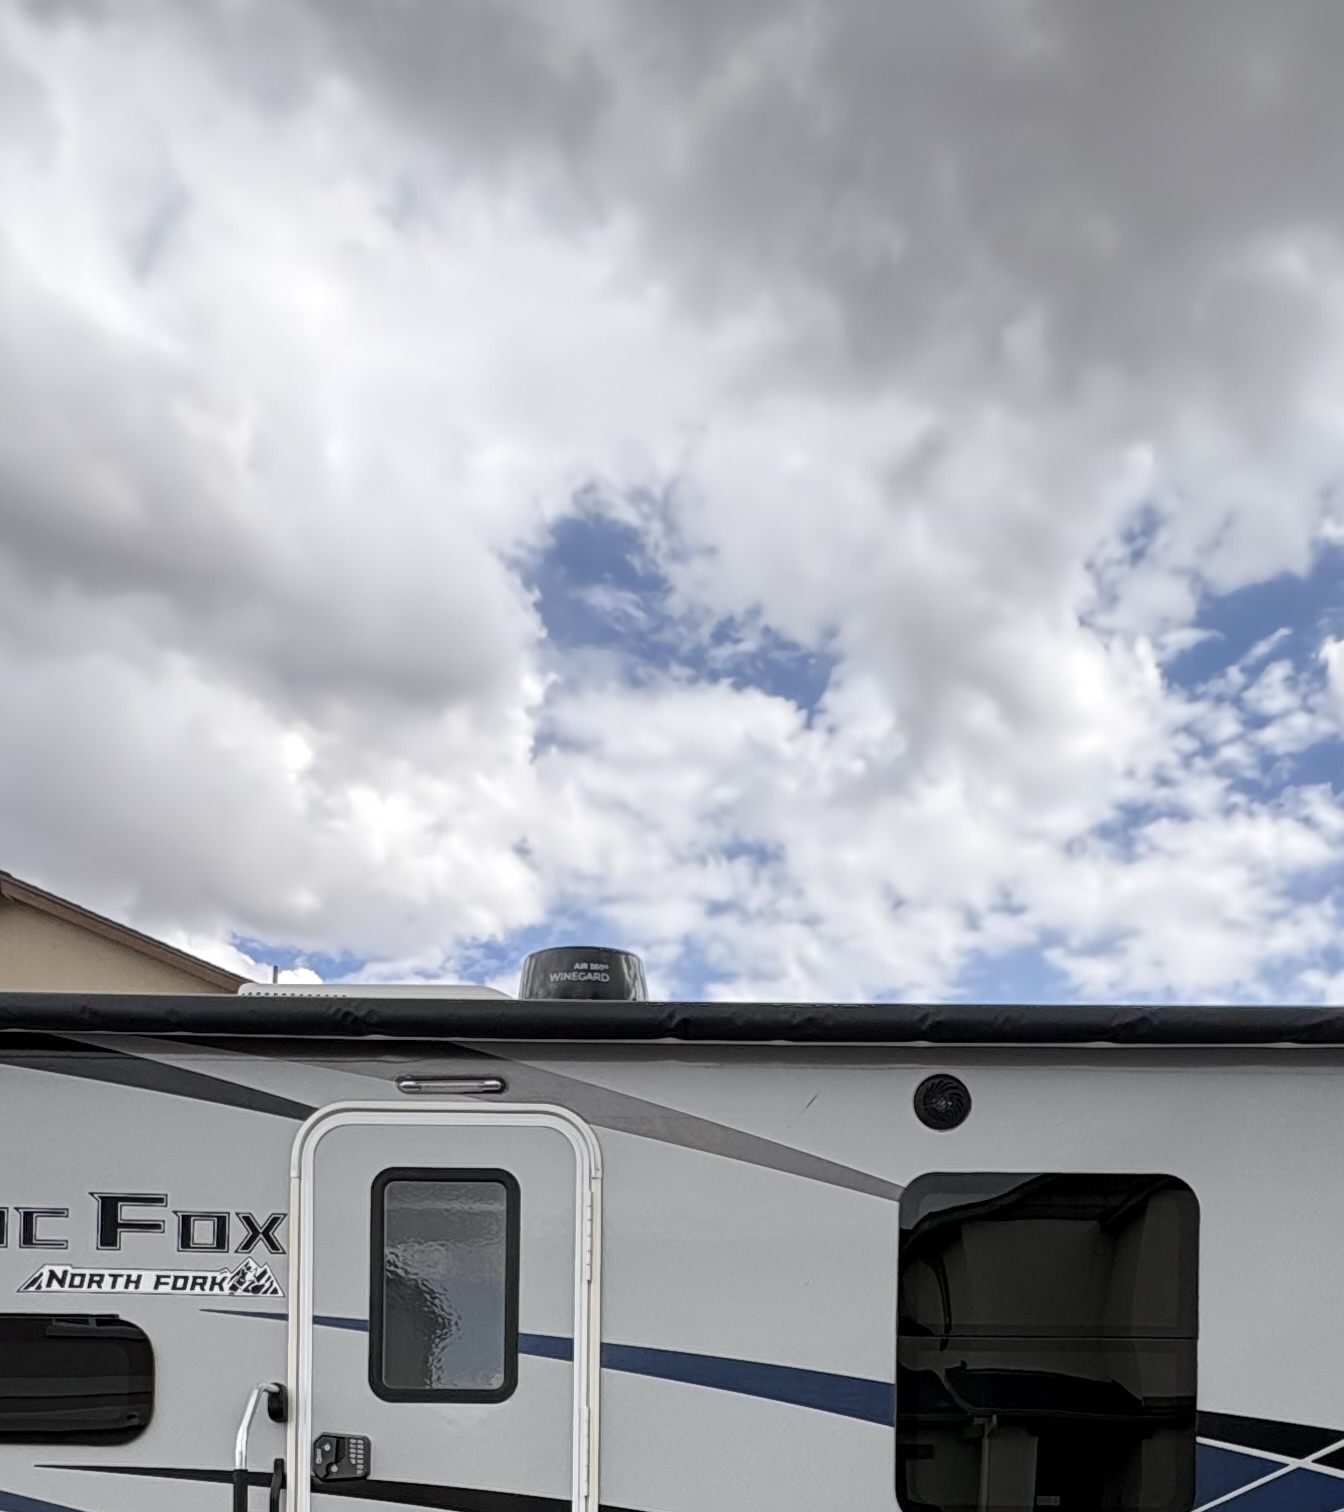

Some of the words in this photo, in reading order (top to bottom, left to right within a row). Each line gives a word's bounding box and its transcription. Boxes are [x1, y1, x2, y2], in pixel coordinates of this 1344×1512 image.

[549, 971, 611, 983] WINEGARD
[88, 1191, 288, 1256] FOX
[46, 1267, 143, 1291] NORTH
[153, 1273, 226, 1294] FORK
